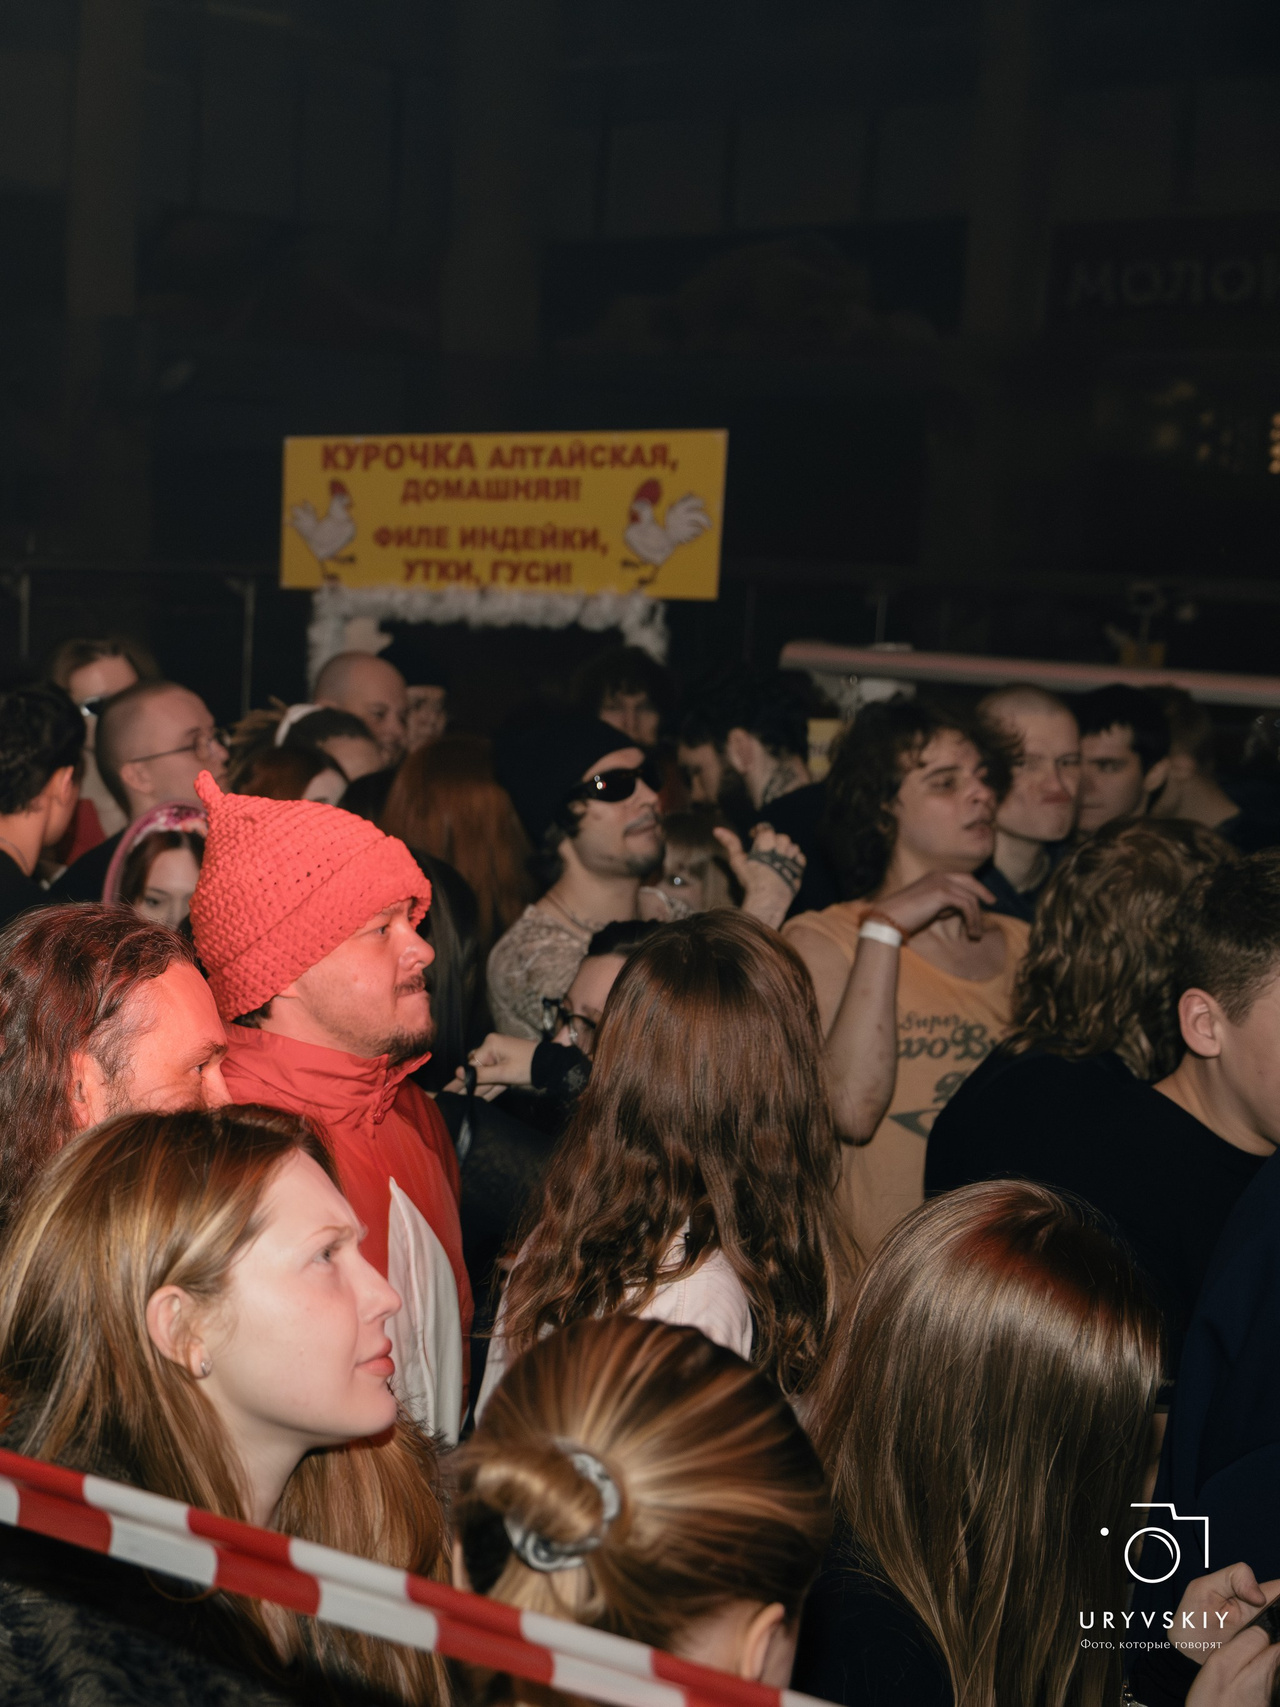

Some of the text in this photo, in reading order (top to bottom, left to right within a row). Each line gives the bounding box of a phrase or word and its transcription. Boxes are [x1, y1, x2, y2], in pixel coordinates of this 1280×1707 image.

[322, 439, 678, 472] КУРОЧКА АЛТАЙСКАЯ,
[401, 477, 581, 505] ДОМАШНЯЯ!
[373, 522, 609, 557] ФИЛЕ ИНДЕЙКИ,
[403, 558, 573, 585] УТКИ, ГУСИ!
